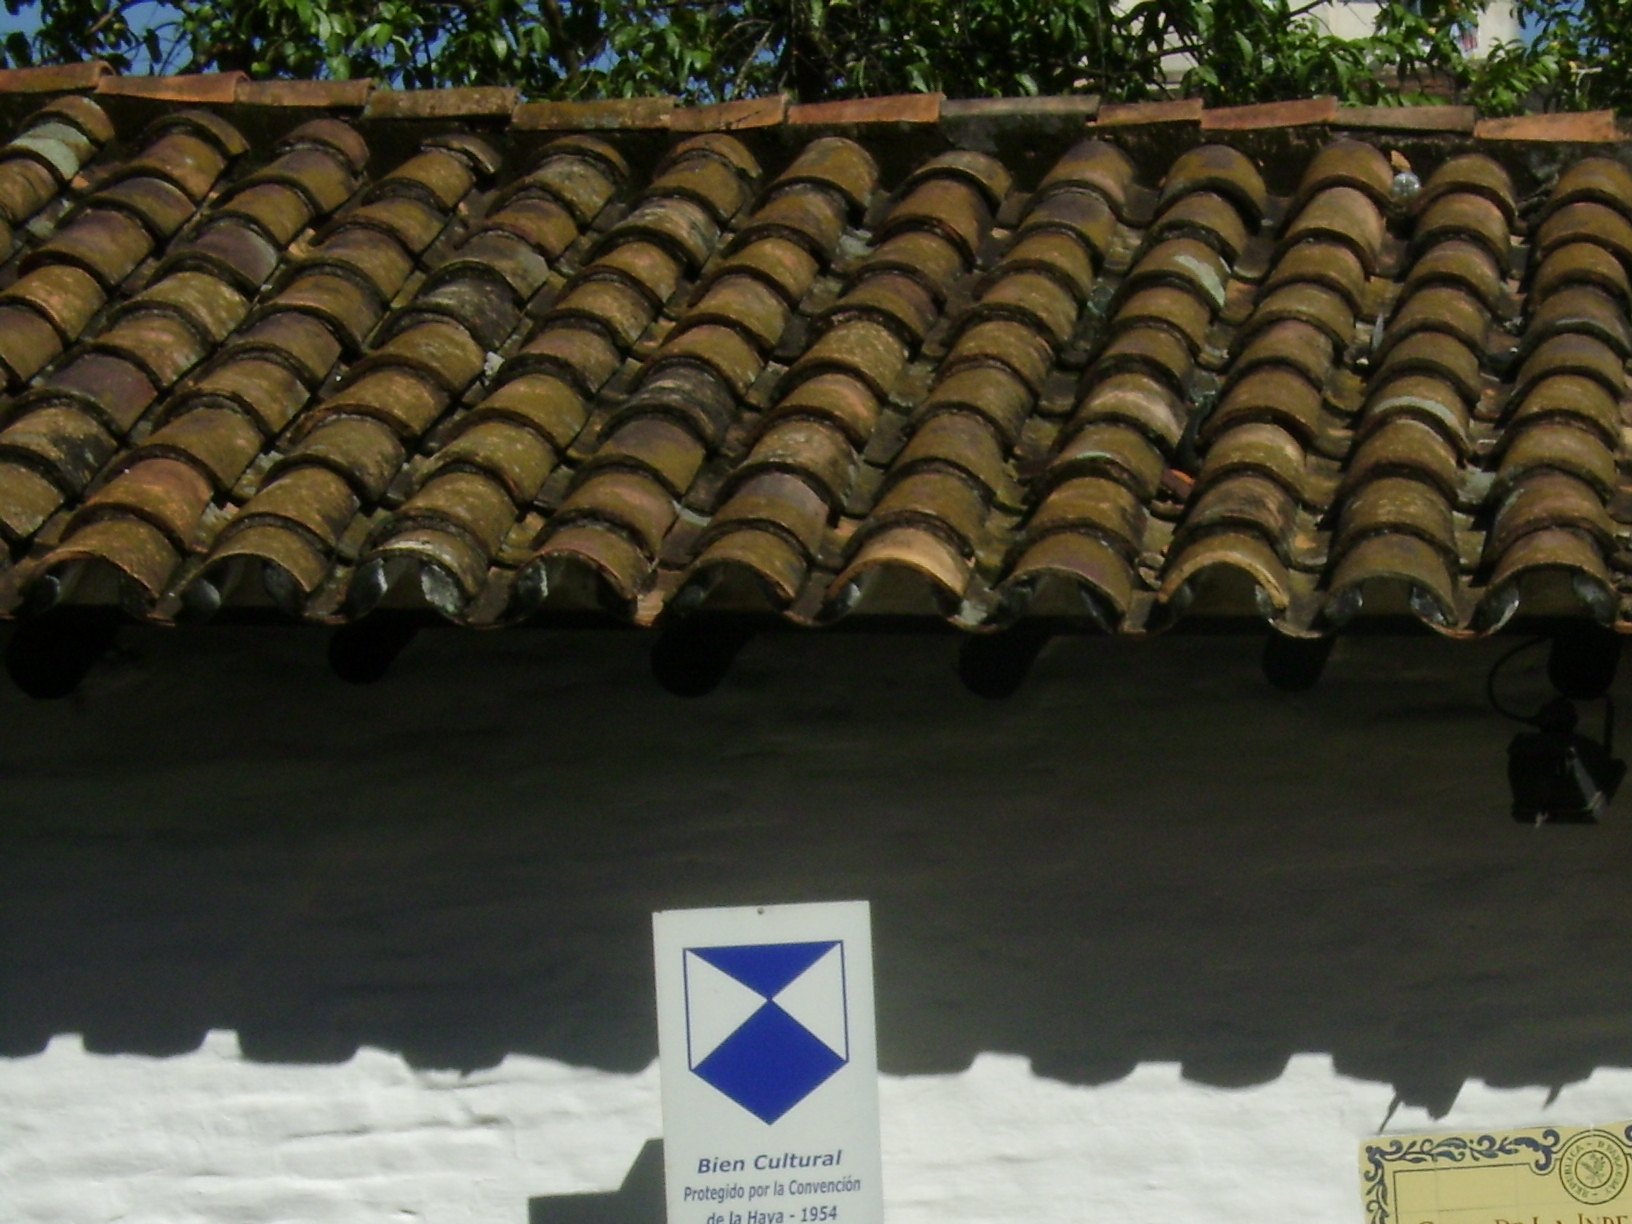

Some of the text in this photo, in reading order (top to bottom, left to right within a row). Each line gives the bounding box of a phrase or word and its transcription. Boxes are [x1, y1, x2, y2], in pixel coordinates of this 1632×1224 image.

[697, 1150, 843, 1174] Bien Cultural
[684, 1175, 861, 1204] Protegido por la Convención
[800, 1205, 838, 1222] 1954
